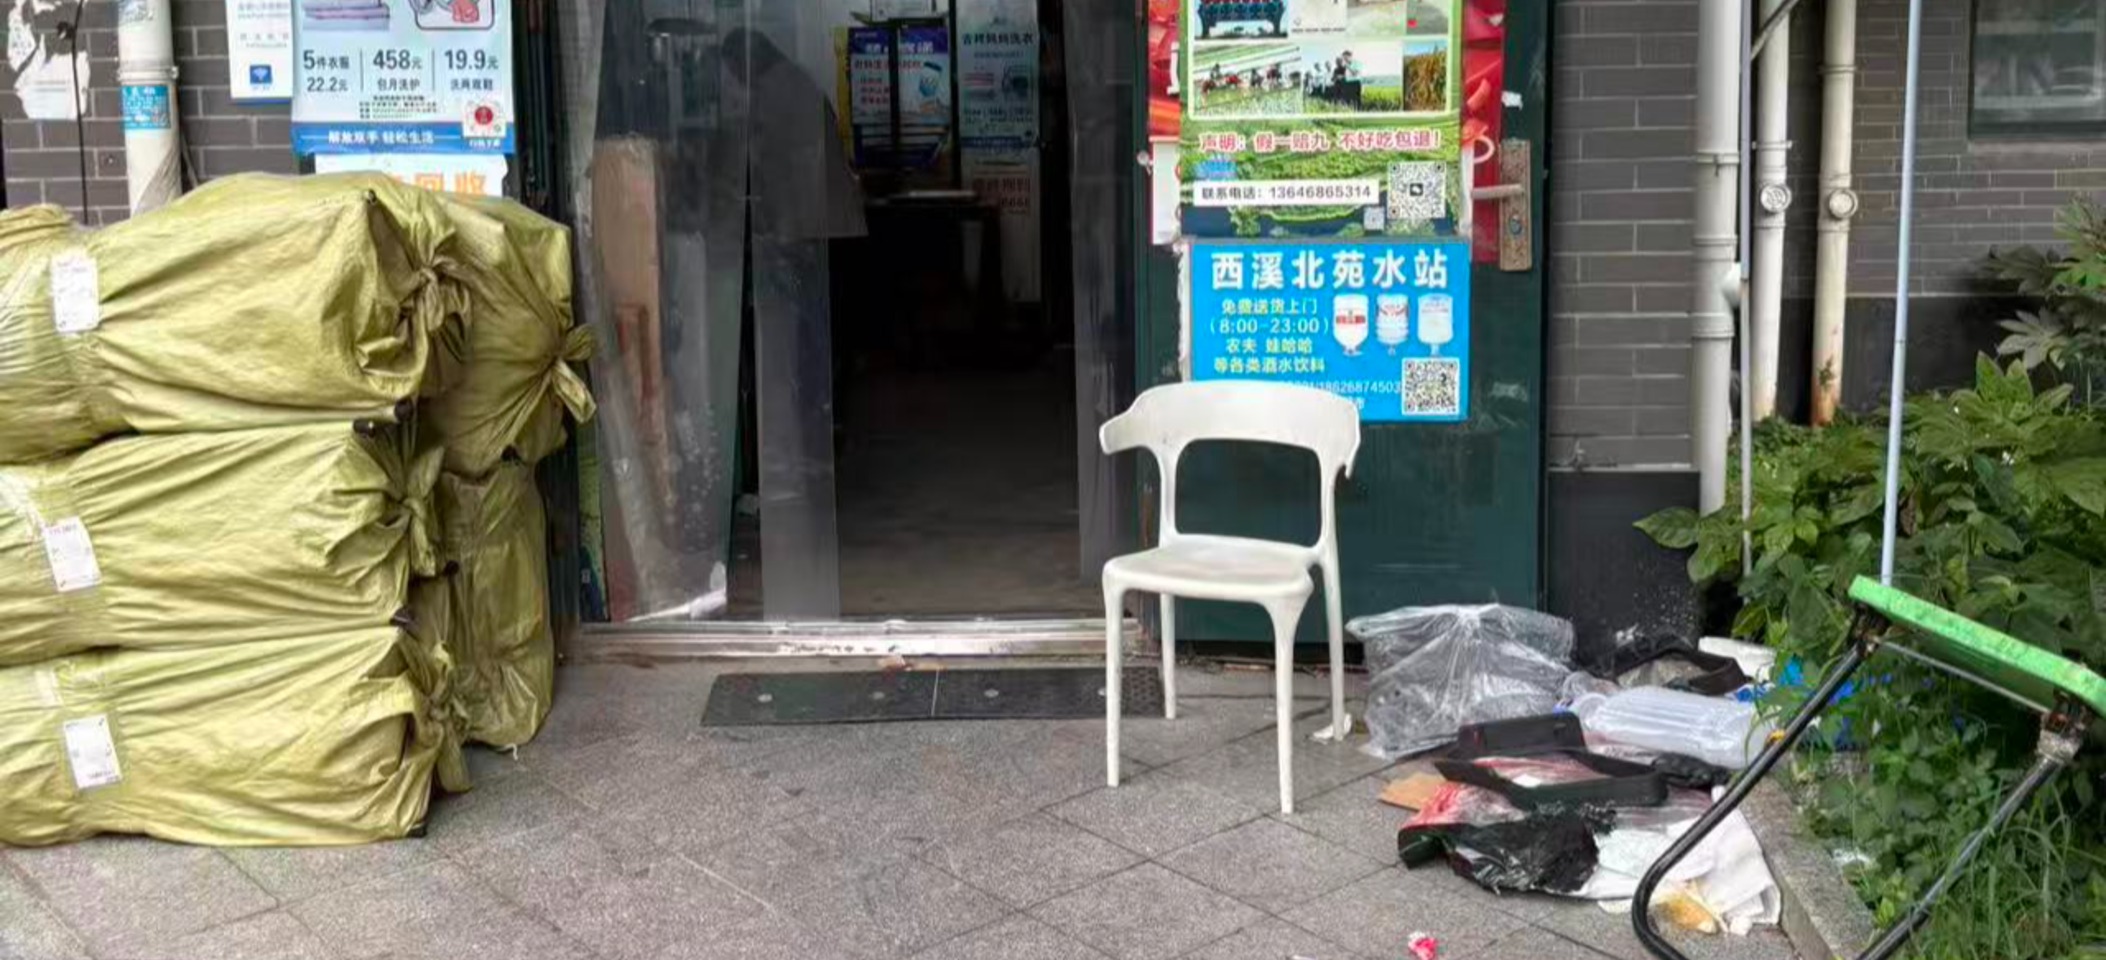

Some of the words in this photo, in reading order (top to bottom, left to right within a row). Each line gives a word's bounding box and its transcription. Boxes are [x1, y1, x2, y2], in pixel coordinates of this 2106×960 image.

[303, 50, 350, 70] 5件衣服
[373, 50, 422, 70] 458元
[445, 50, 499, 70] 19.9元
[307, 77, 348, 92] 22.2元
[377, 77, 420, 92] 包月洗护
[1211, 249, 1449, 290] 西溪北苑水站
[1222, 298, 1318, 315] 免费送货上门
[1226, 338, 1257, 354] 农夫
[1266, 337, 1313, 354] 娃哈哈
[1213, 356, 1325, 373] 等各类酒水饮料
